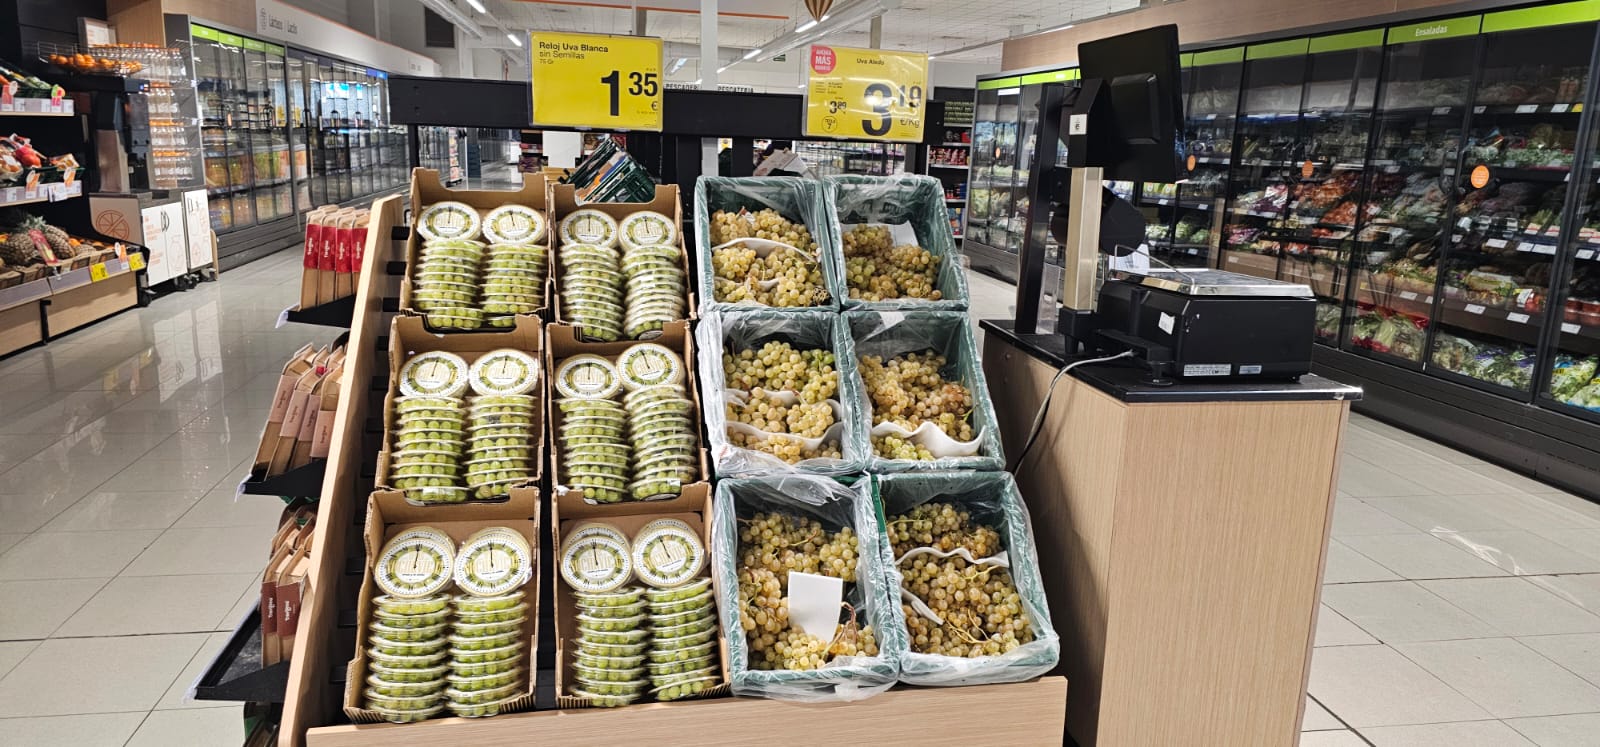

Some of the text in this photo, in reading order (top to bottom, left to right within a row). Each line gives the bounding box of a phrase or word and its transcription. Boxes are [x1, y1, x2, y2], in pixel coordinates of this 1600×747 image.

[1415, 25, 1448, 36] Ensaladas
[539, 41, 560, 51] Reloj
[581, 44, 609, 52] Blanca
[553, 51, 584, 59] Semillas
[601, 70, 658, 116] 1 35
[862, 83, 922, 136] 3 19
